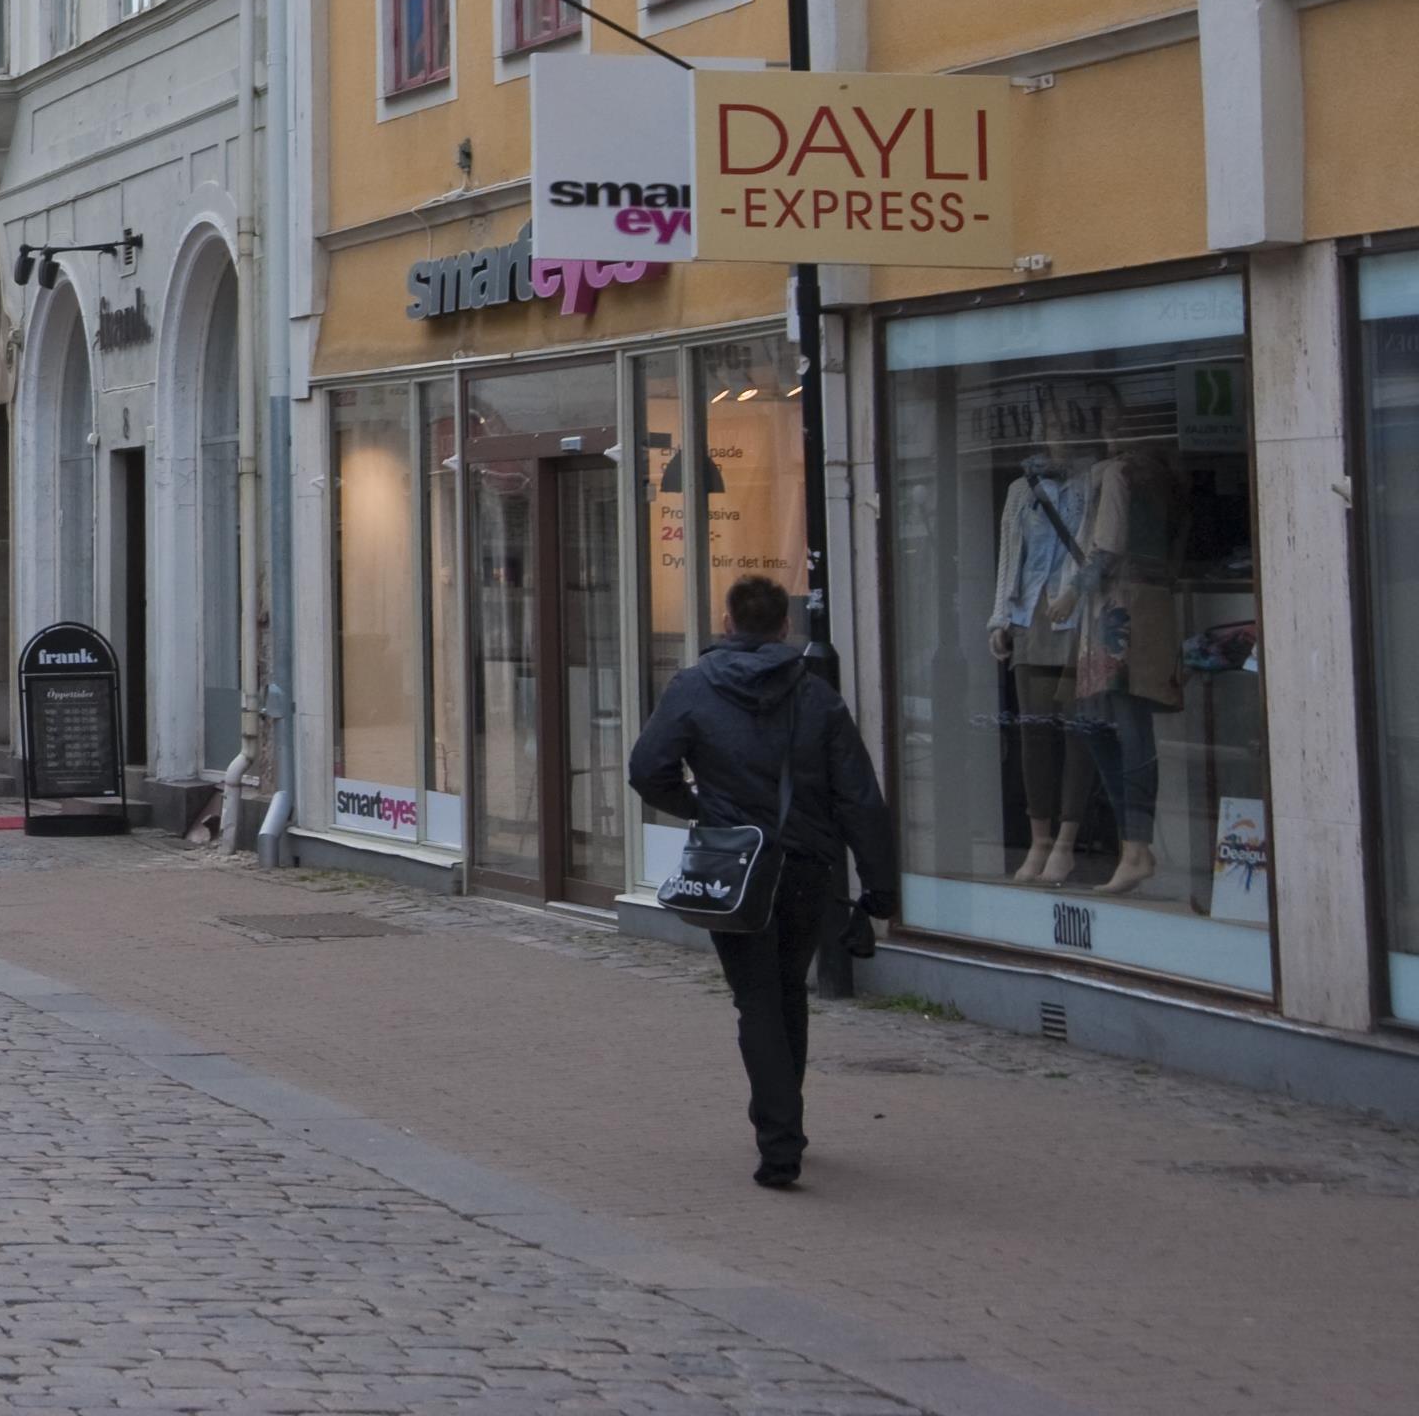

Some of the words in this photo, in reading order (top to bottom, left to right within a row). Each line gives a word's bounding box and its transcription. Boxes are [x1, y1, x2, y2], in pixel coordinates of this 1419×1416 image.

[718, 103, 989, 182] DAYLI
[712, 553, 734, 568] blir
[737, 554, 759, 568] det
[38, 648, 98, 665] frank.
[337, 789, 417, 830] smarteyes
